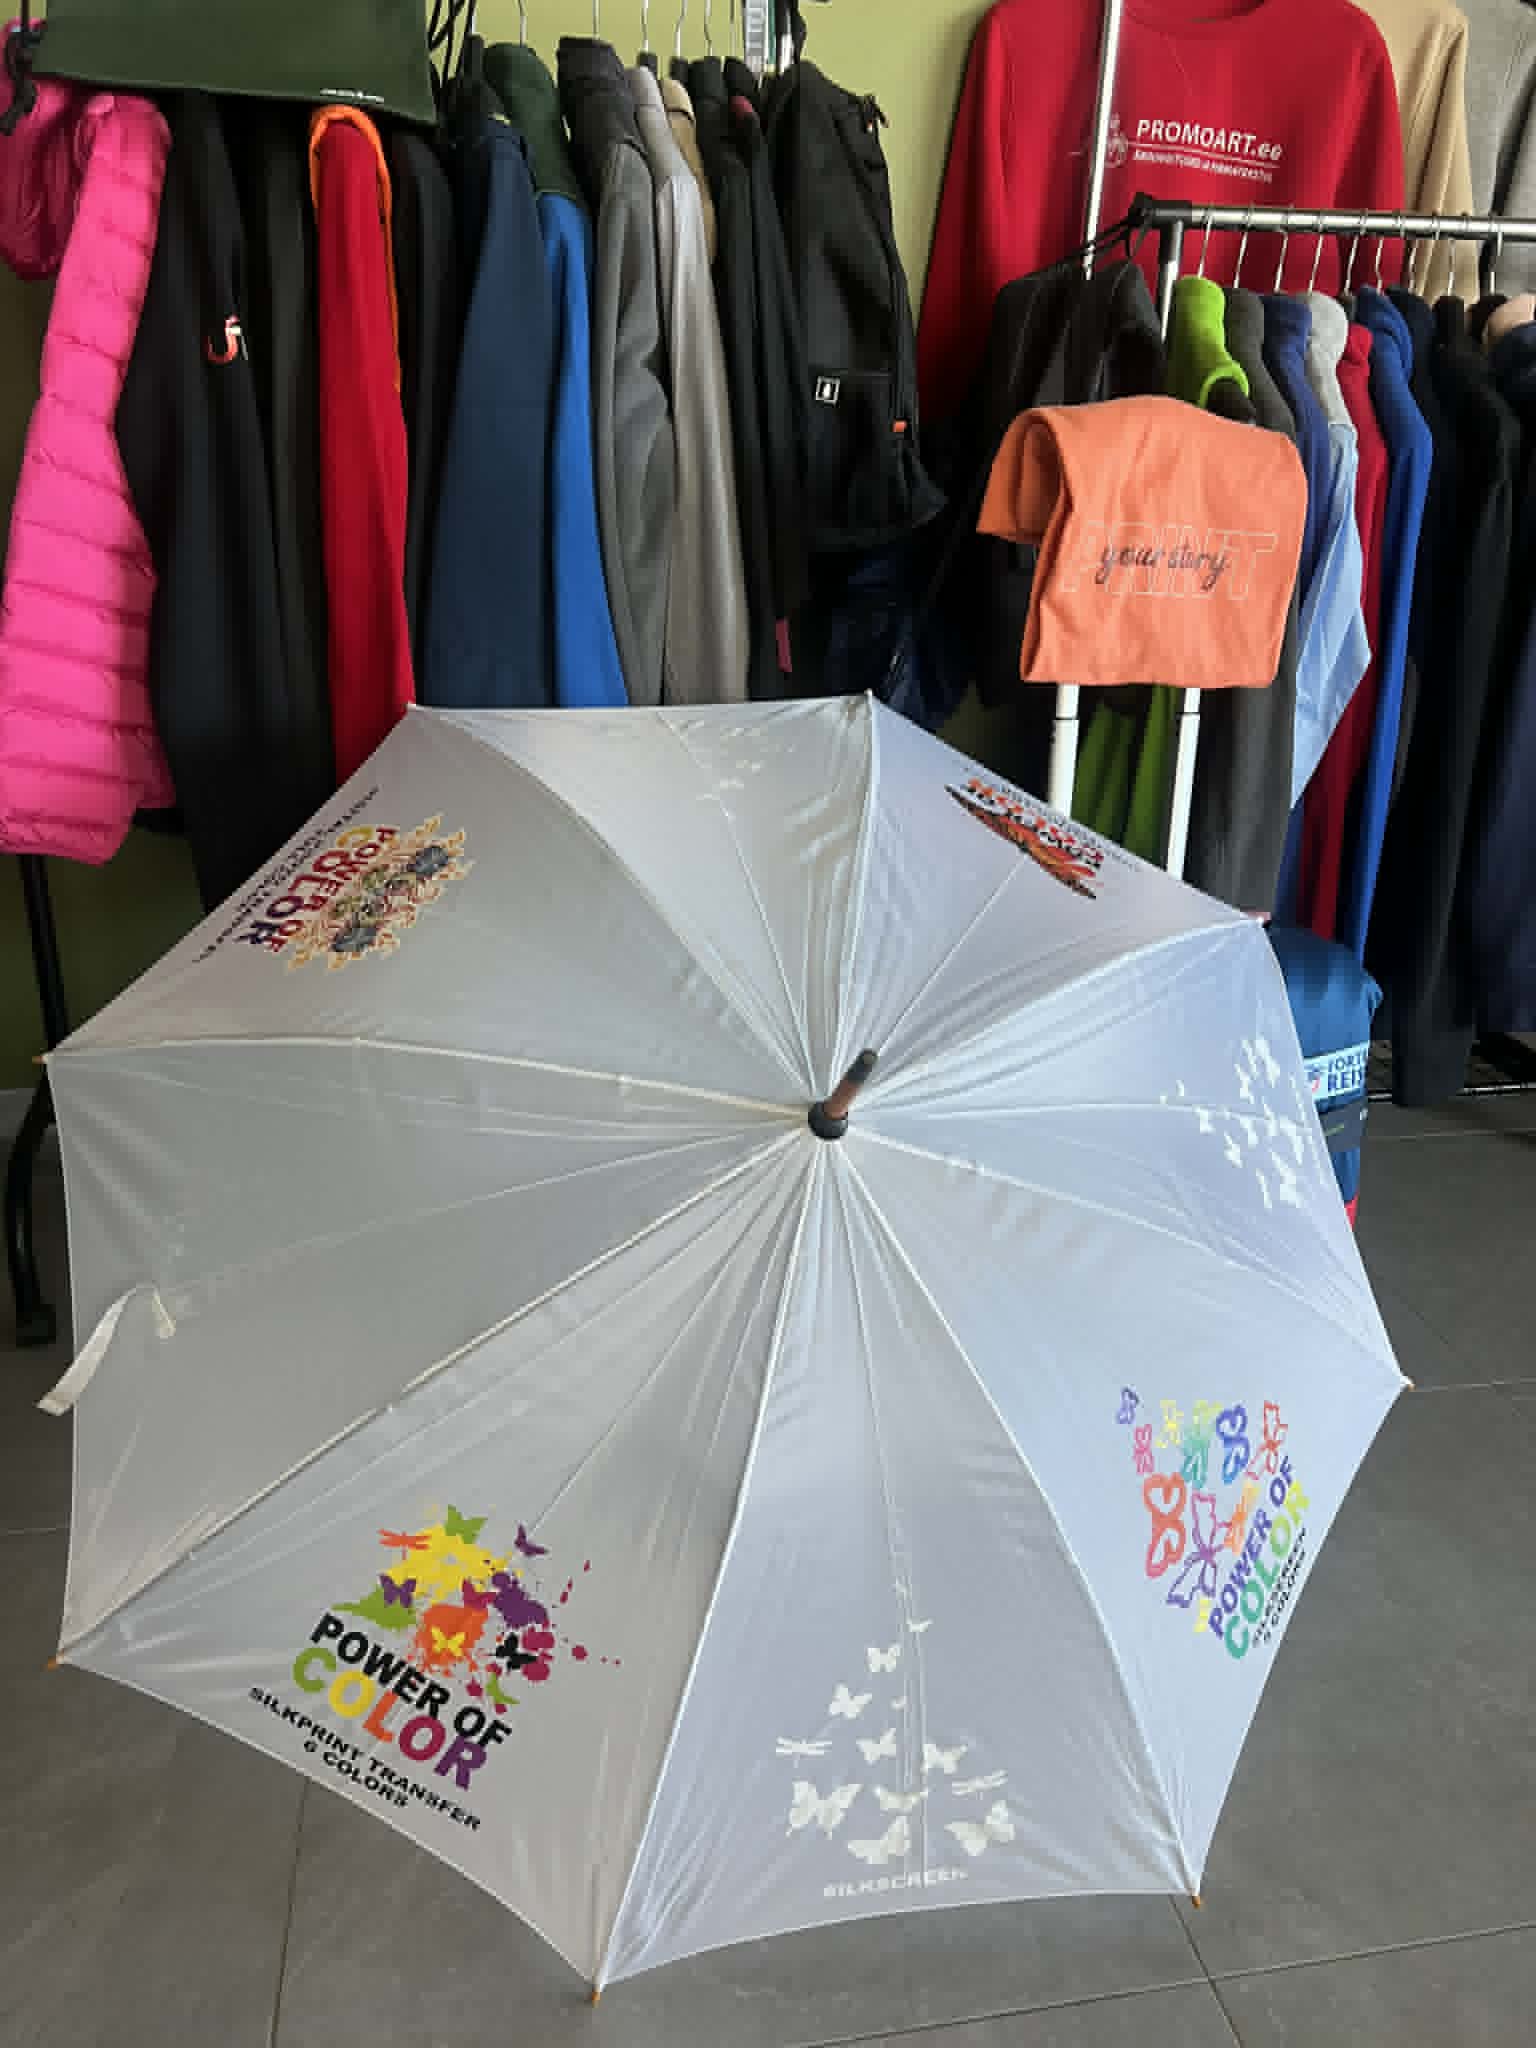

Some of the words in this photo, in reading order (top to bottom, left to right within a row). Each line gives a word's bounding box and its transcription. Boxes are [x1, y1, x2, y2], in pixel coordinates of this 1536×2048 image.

[1137, 119, 1283, 161] PROMOART.ee
[1095, 544, 1163, 584] your
[233, 826, 374, 945] COLOR
[1208, 1508, 1273, 1639] POWER
[1269, 1455, 1293, 1508] OF
[1225, 1479, 1310, 1660] COLOR
[293, 1647, 488, 1791] COLOR
[309, 1612, 450, 1720] POWER
[453, 1706, 513, 1749] OF
[248, 1686, 364, 1761] SILKPRINT
[368, 1757, 481, 1832] TRANSFER
[322, 1751, 409, 1808] COLORS
